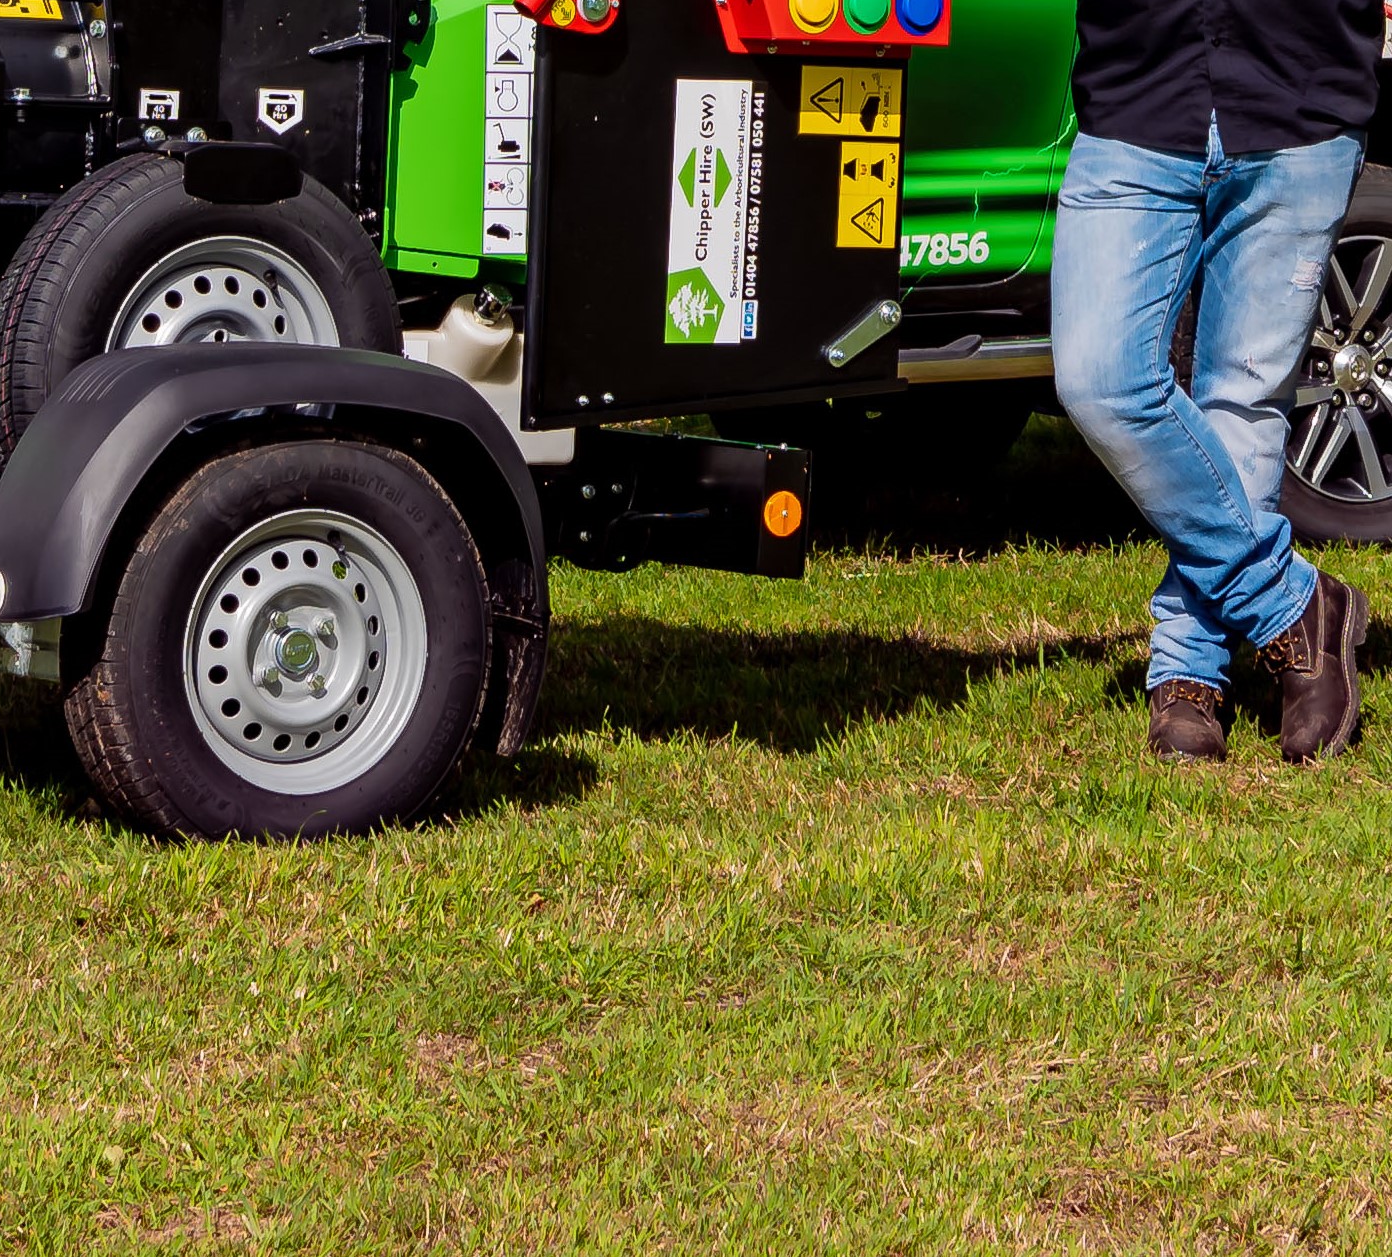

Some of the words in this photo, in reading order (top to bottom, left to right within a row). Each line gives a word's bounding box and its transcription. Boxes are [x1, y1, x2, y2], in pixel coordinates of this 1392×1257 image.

[700, 94, 716, 139] (SW)
[738, 89, 748, 131] Industry
[754, 93, 765, 117] 441
[752, 120, 764, 146] 050
[699, 145, 713, 184] Hire
[734, 135, 745, 207] Arboricultural
[750, 153, 762, 194] 07581
[695, 190, 713, 262] Chipper
[734, 211, 742, 228] the
[734, 231, 741, 242] to
[748, 207, 760, 252] 47856
[730, 245, 740, 299] Specialists
[745, 255, 757, 297] 01404
